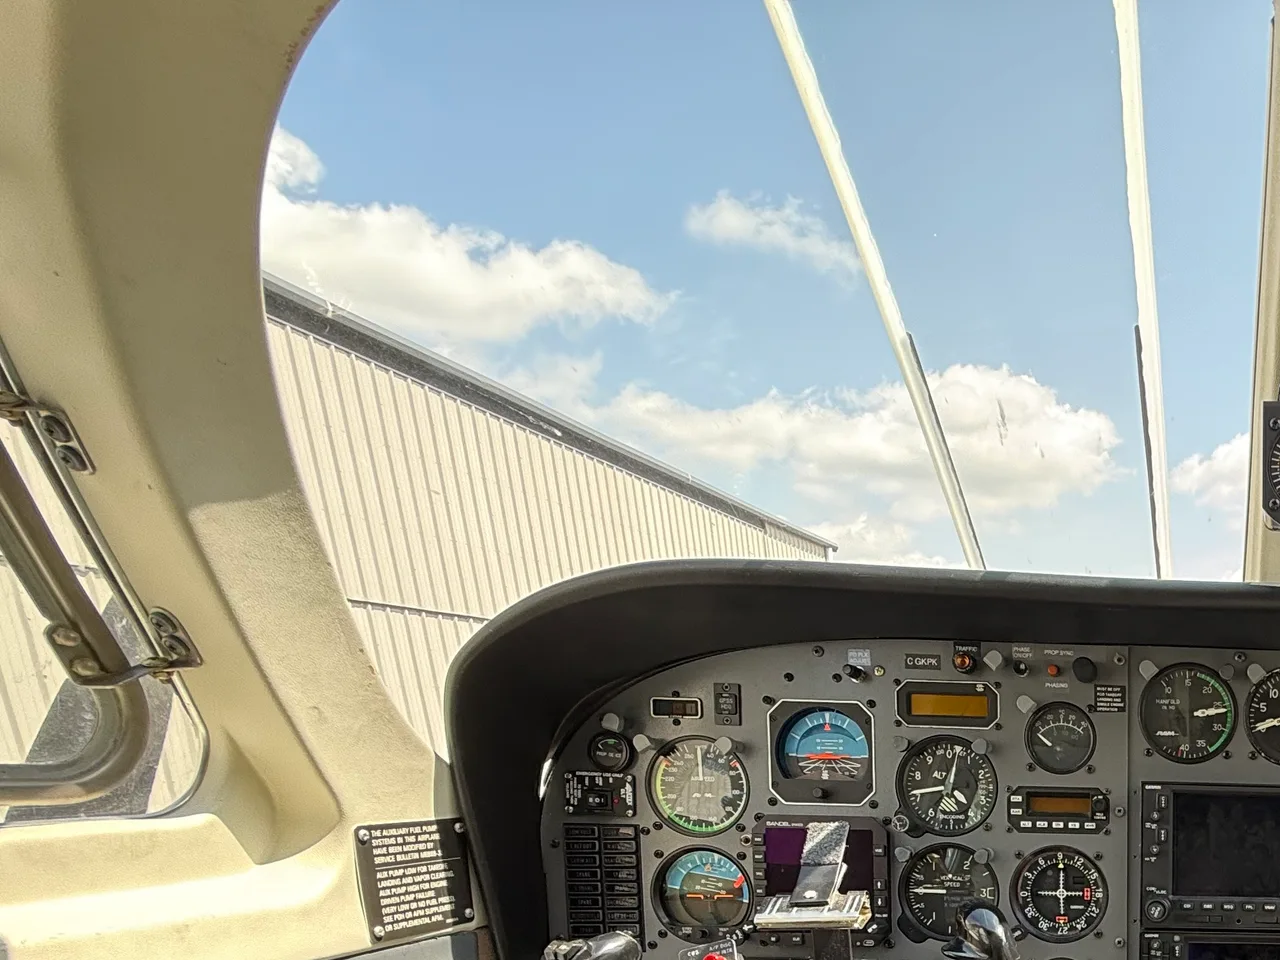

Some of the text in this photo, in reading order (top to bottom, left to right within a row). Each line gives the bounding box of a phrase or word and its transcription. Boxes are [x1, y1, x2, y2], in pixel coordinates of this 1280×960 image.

[915, 657, 938, 666] GKPK
[1202, 686, 1213, 694] 20
[1269, 689, 1279, 699] 10
[1260, 703, 1267, 712] 5
[1196, 740, 1206, 748] 35
[946, 749, 953, 758] 0
[926, 756, 933, 764] 9
[915, 771, 921, 780] 8
[932, 771, 947, 779] ALT
[978, 770, 985, 779] 2
[980, 796, 986, 804] 3
[928, 808, 935, 817] 6
[1074, 856, 1084, 865] 12
[964, 861, 970, 870] 2
[1024, 871, 1032, 879] 3
[1089, 868, 1098, 880] 15
[1095, 889, 1103, 898] 18
[1024, 906, 1035, 917] 33
[1039, 920, 1050, 931] 30
[1058, 926, 1069, 935] 27
